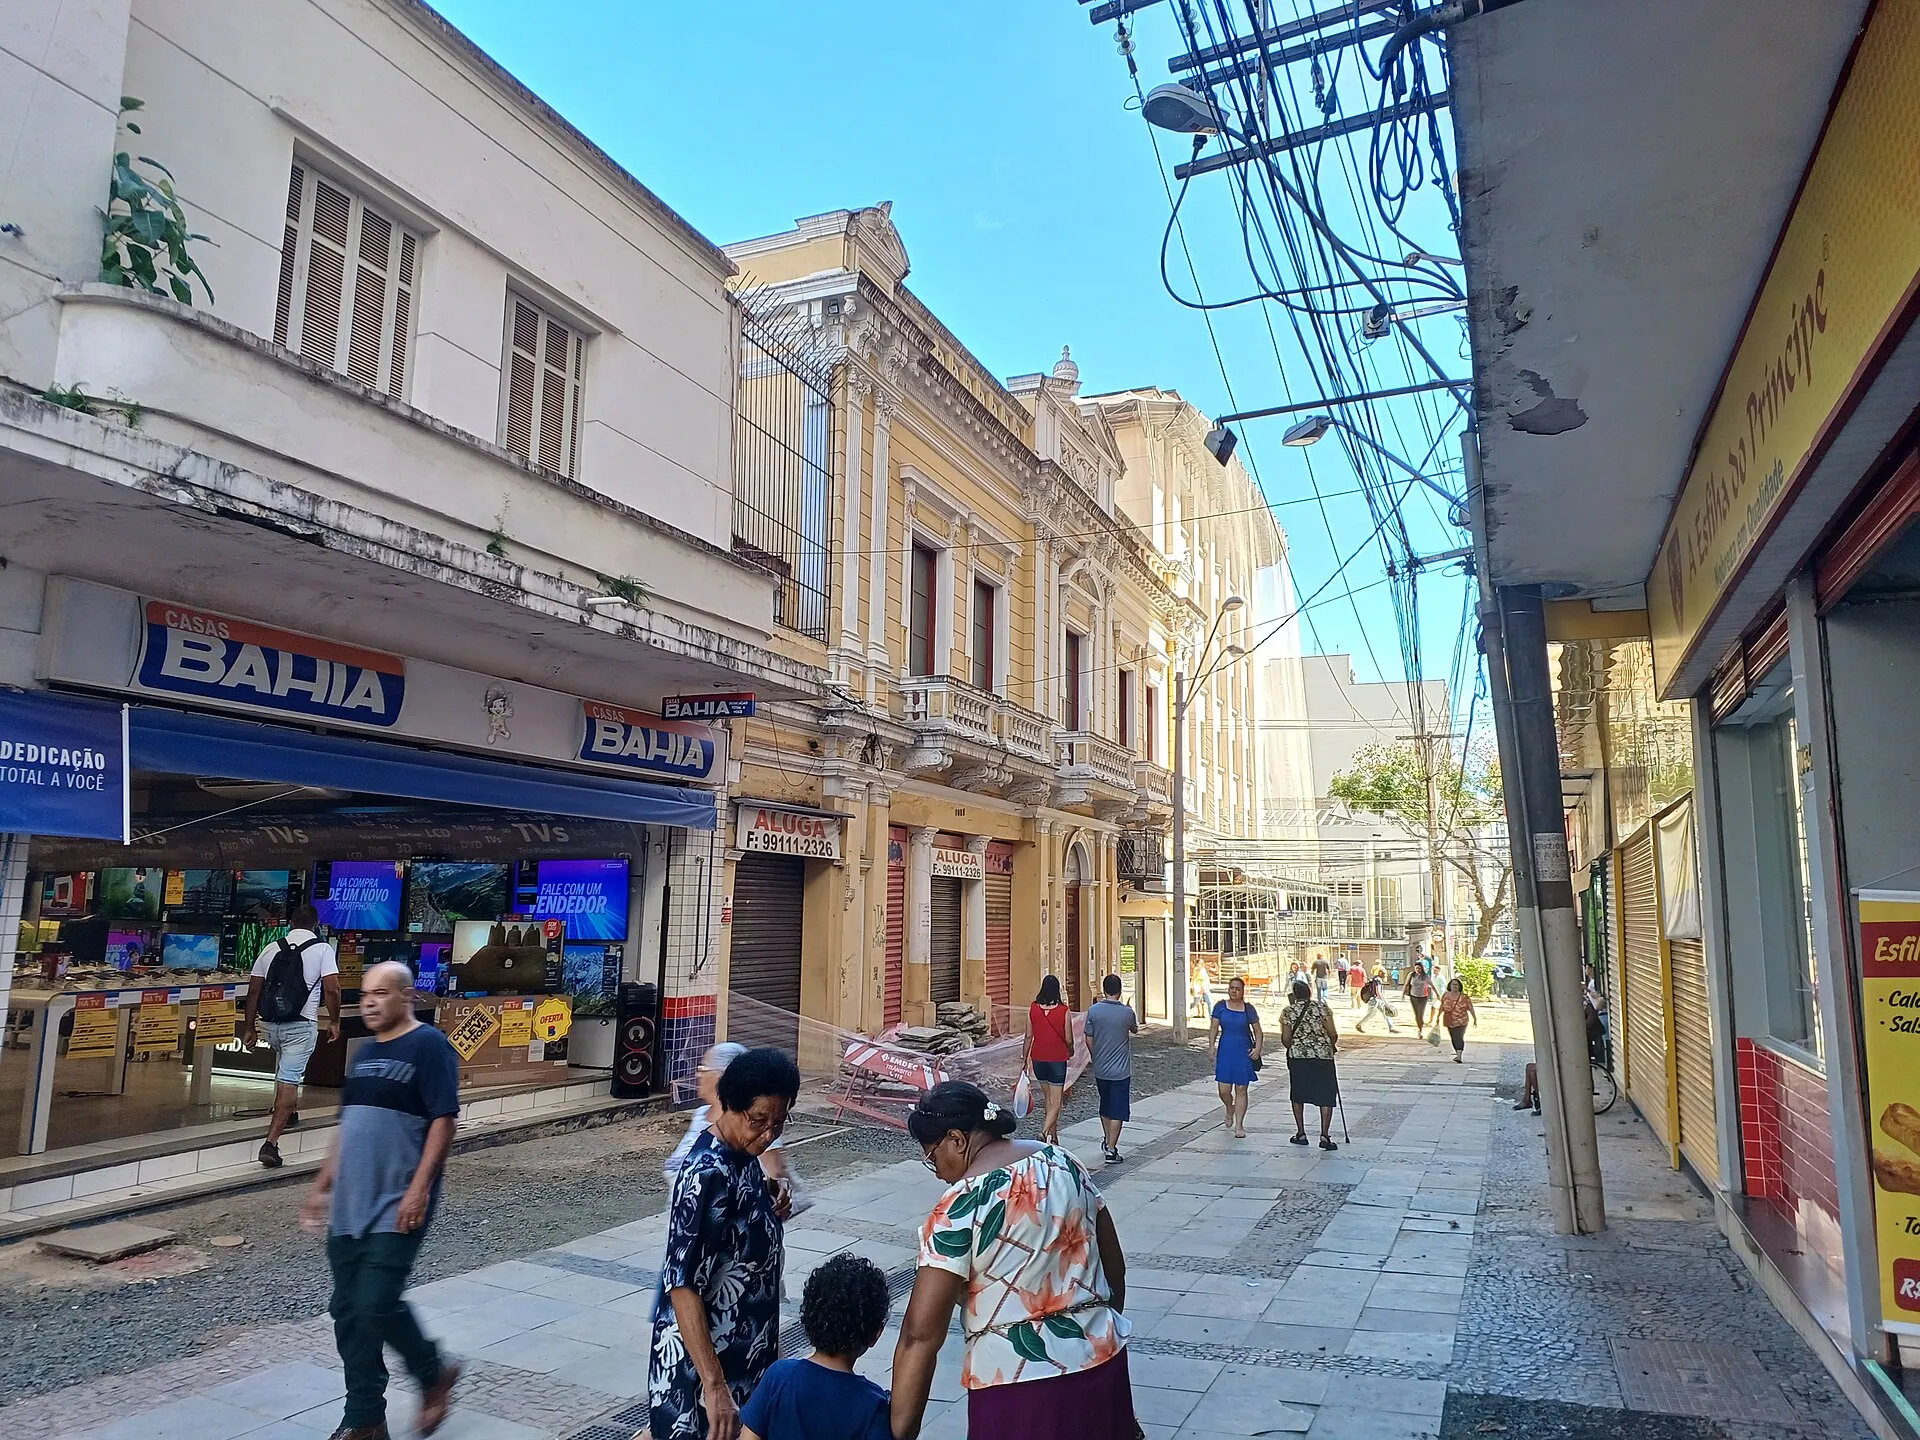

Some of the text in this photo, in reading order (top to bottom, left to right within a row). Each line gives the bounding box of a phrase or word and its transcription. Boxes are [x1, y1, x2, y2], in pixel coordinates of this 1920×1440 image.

[1746, 457, 1784, 534] Qualidade
[1688, 534, 1697, 584] A
[1728, 437, 1747, 500] do
[164, 609, 230, 639] CASAS
[160, 627, 386, 714] BAHIA
[592, 706, 625, 723] CASAS
[665, 701, 730, 718] BAHIA
[591, 719, 704, 770] BAHIA
[0, 740, 105, 771] DEDICAÇÃO
[0, 766, 105, 791] TOTAL A VOCÊ
[754, 808, 826, 838] ALUGA
[259, 826, 309, 844] TVs
[424, 828, 451, 838] LCD
[511, 823, 569, 842] TVs
[746, 831, 833, 857] F: 99111-2326
[936, 850, 978, 866] ALUGA
[943, 864, 981, 878] 99111-2326
[336, 877, 379, 888] NA COMPRA
[540, 883, 603, 895] FALE COM UM
[326, 888, 389, 902] DE UM NOVO
[333, 901, 377, 911] SMARTPHONE
[455, 1006, 470, 1017] LG
[540, 1013, 564, 1024] OFERTA
[453, 1009, 484, 1041] COMPRE
[463, 1012, 489, 1042] LEVE
[463, 1044, 472, 1053] NA
[471, 1020, 494, 1044] HORA
[889, 1057, 919, 1071] EMDEC
